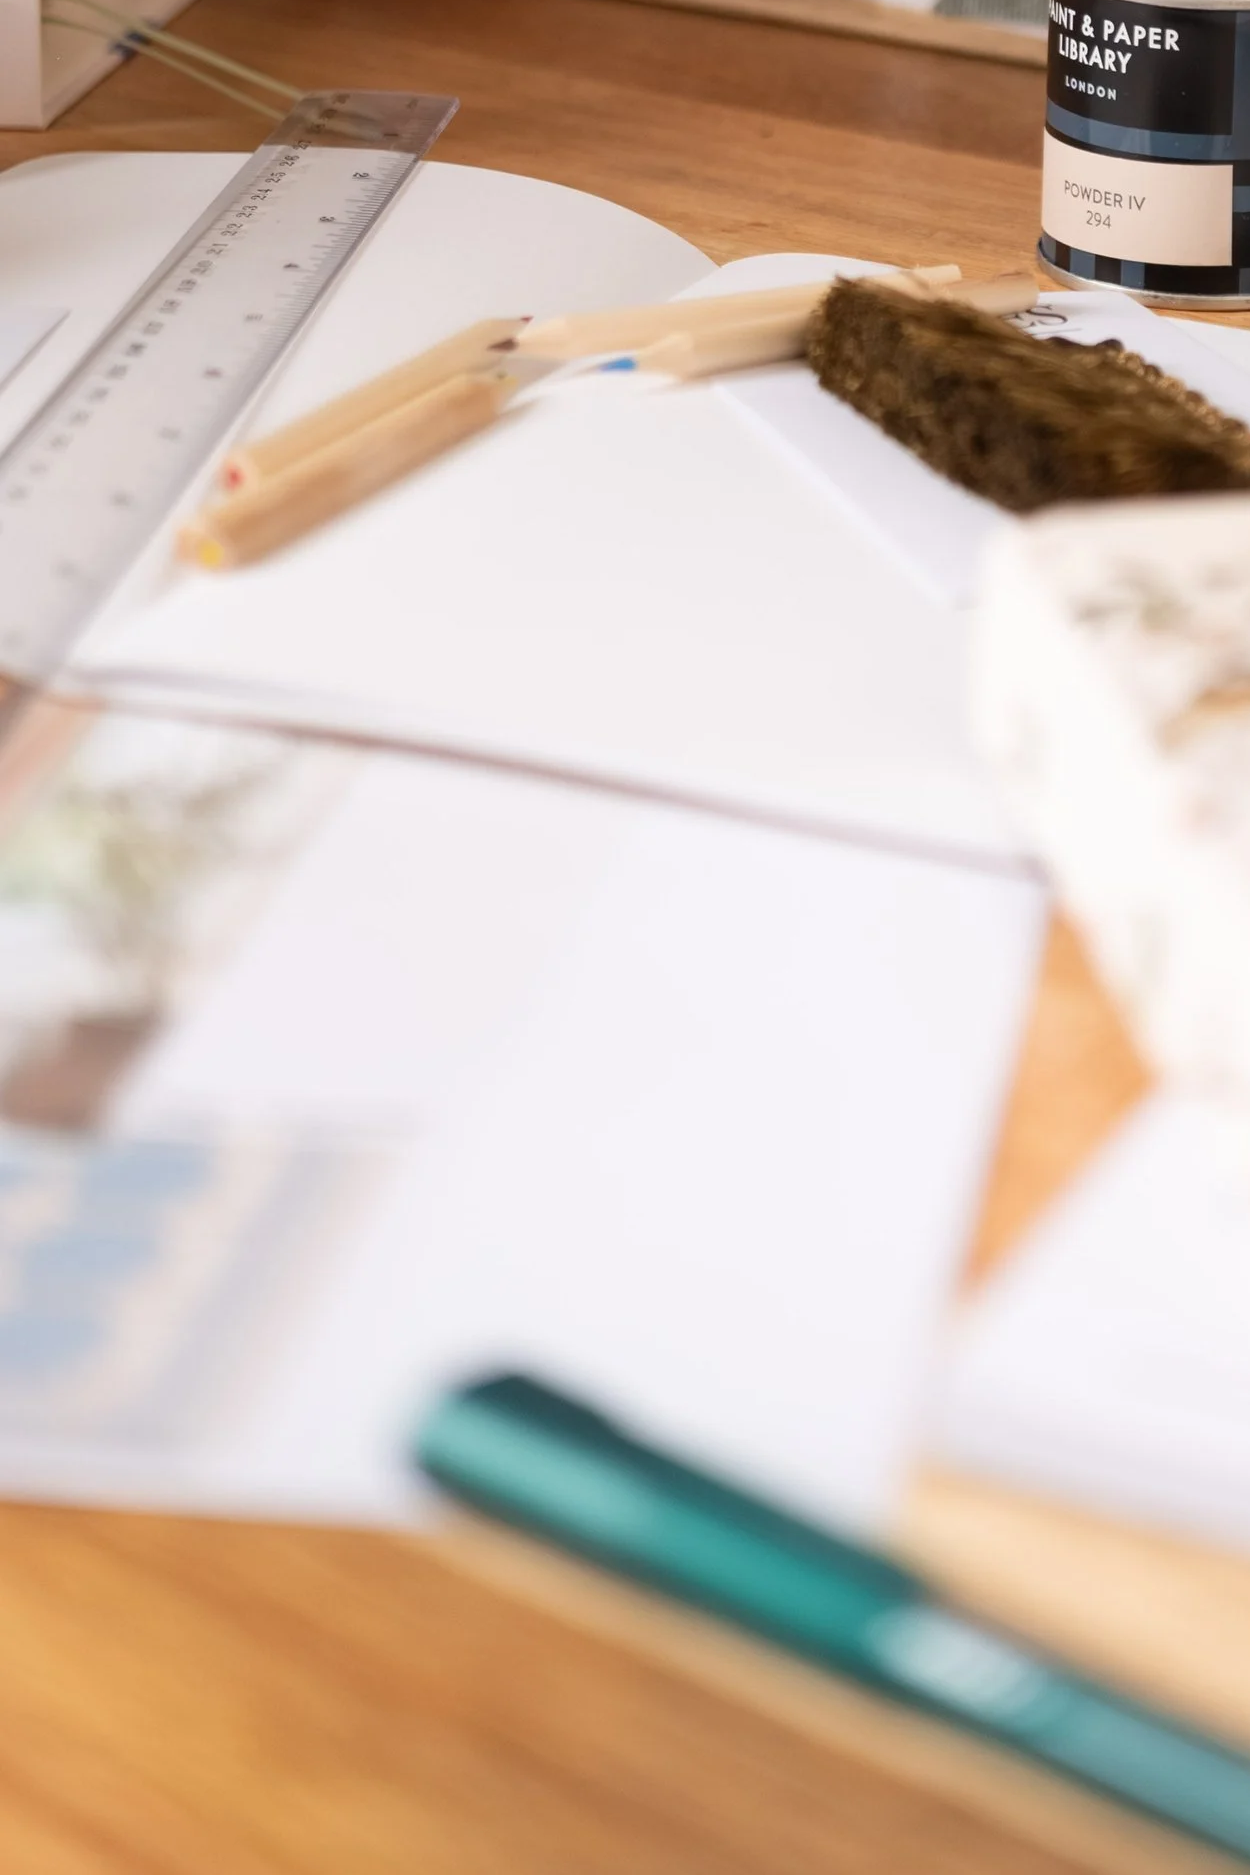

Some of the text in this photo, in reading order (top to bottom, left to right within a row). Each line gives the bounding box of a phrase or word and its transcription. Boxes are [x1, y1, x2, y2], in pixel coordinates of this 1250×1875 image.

[1081, 14, 1095, 38] &
[1103, 19, 1180, 51] PAPER
[1058, 33, 1132, 74] LIBRARY
[1065, 75, 1117, 101] LONDON
[206, 242, 229, 255] 21
[221, 223, 243, 237] 22
[236, 205, 258, 218] 23
[251, 188, 272, 200] 24
[265, 171, 286, 183] 25
[279, 155, 300, 167] 26
[1064, 180, 1146, 211] POWDER IV
[319, 215, 337, 223] 3
[1086, 210, 1111, 229] 294
